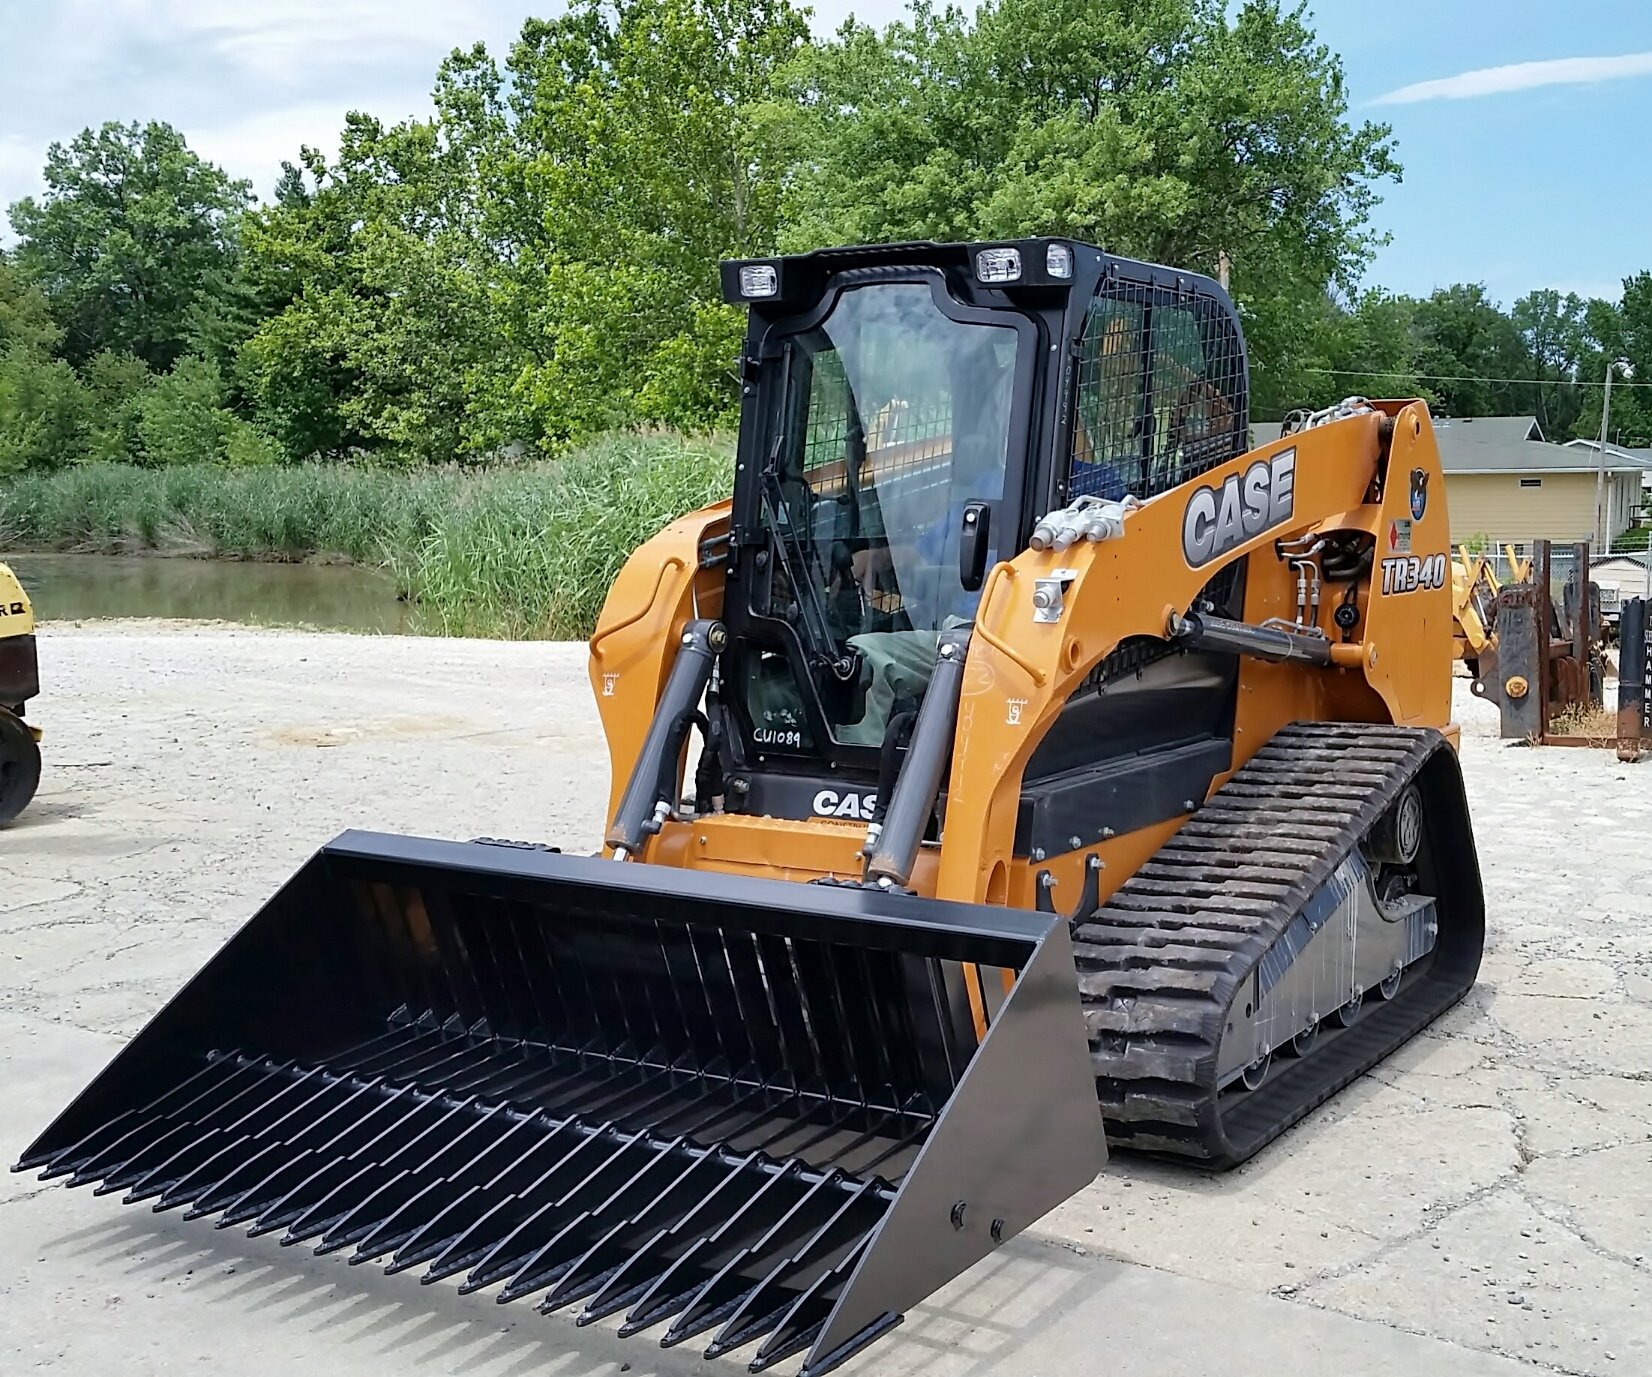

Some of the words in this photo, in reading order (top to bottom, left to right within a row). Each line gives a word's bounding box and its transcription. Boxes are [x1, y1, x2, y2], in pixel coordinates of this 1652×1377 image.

[1183, 447, 1296, 558] CASE
[1381, 553, 1447, 596] TR340
[1643, 646, 1652, 728] HAMMER
[812, 790, 878, 820] CAS
